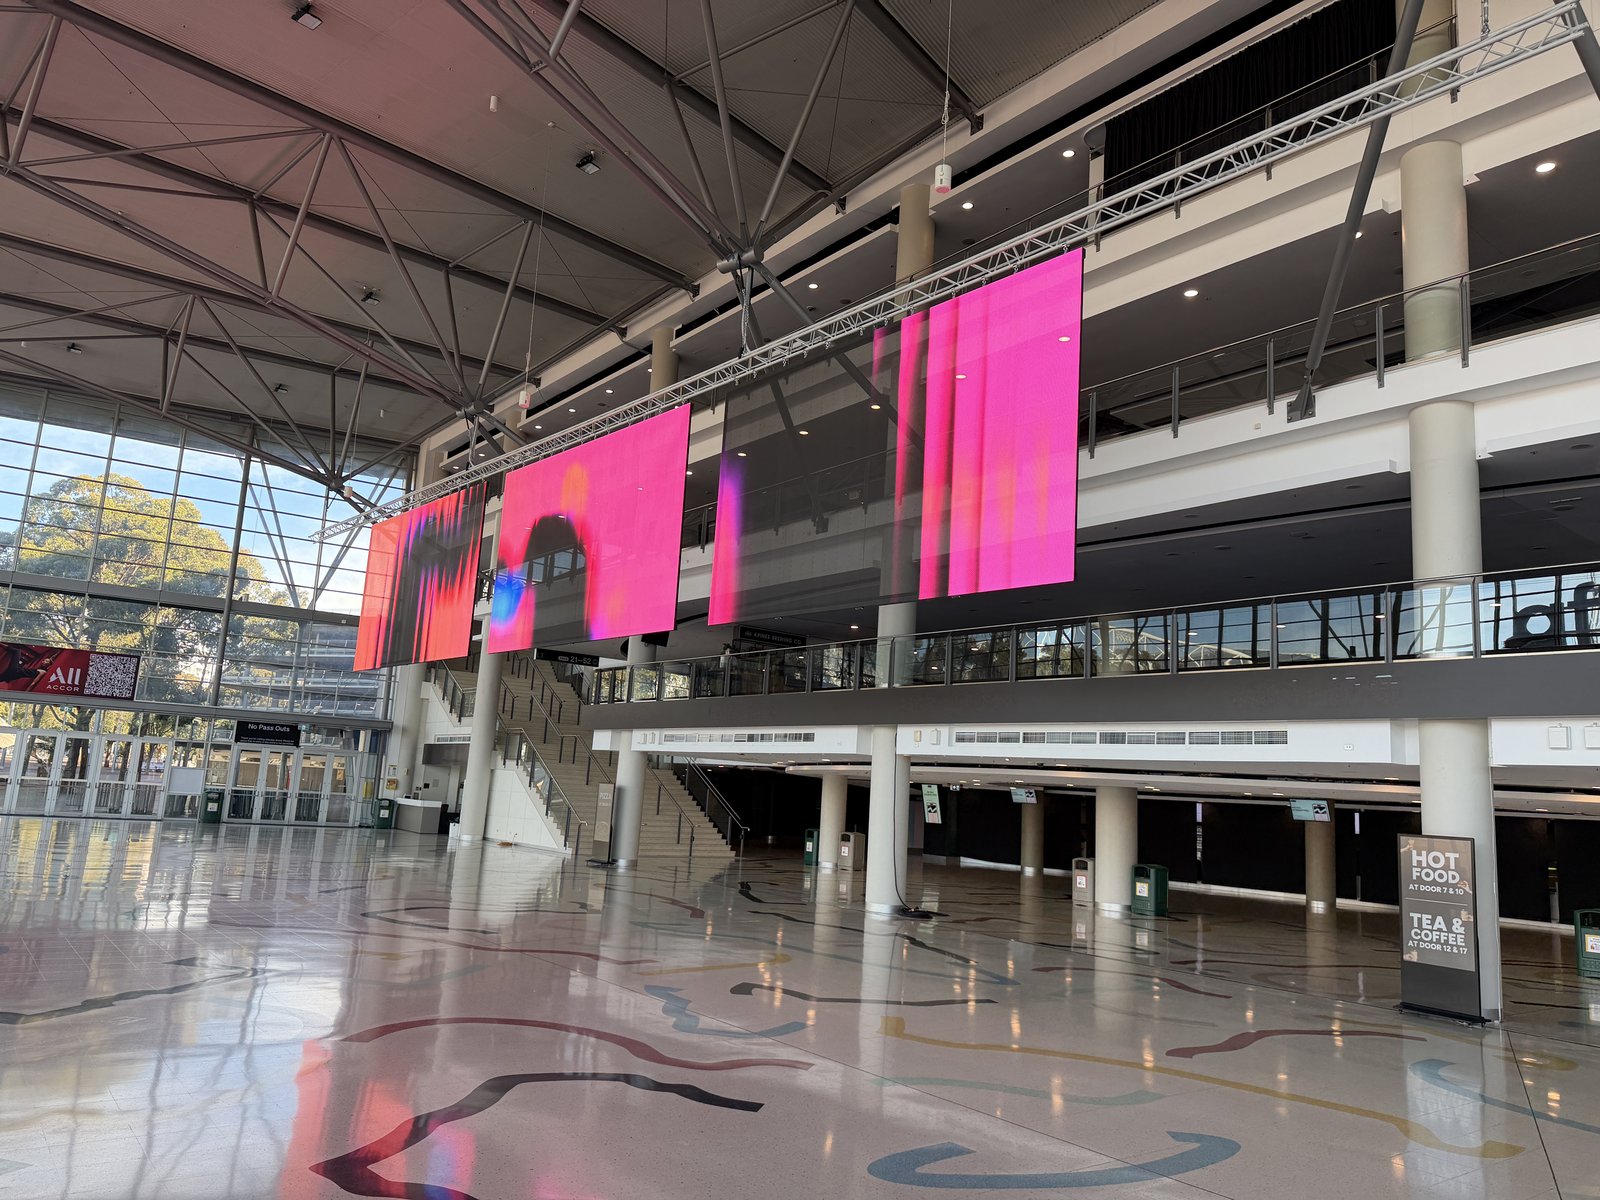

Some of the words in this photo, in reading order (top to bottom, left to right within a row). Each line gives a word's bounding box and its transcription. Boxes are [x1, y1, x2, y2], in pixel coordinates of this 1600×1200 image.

[47, 684, 79, 692] ACCOR
[1411, 849, 1460, 870] HOT
[1412, 867, 1460, 884] FOOD
[1408, 883, 1419, 891] AT
[1419, 884, 1442, 894] DOOR
[1442, 886, 1448, 894] 7
[1448, 887, 1455, 895] &
[1455, 888, 1464, 896] 10
[1409, 912, 1448, 932] TEA
[1451, 917, 1465, 934] &
[1411, 928, 1466, 947] COFFEE
[1408, 940, 1419, 948] AT
[1419, 941, 1442, 951] DOOR
[1443, 945, 1452, 953] 12
[1452, 946, 1459, 954] &
[1459, 947, 1468, 955] 17
